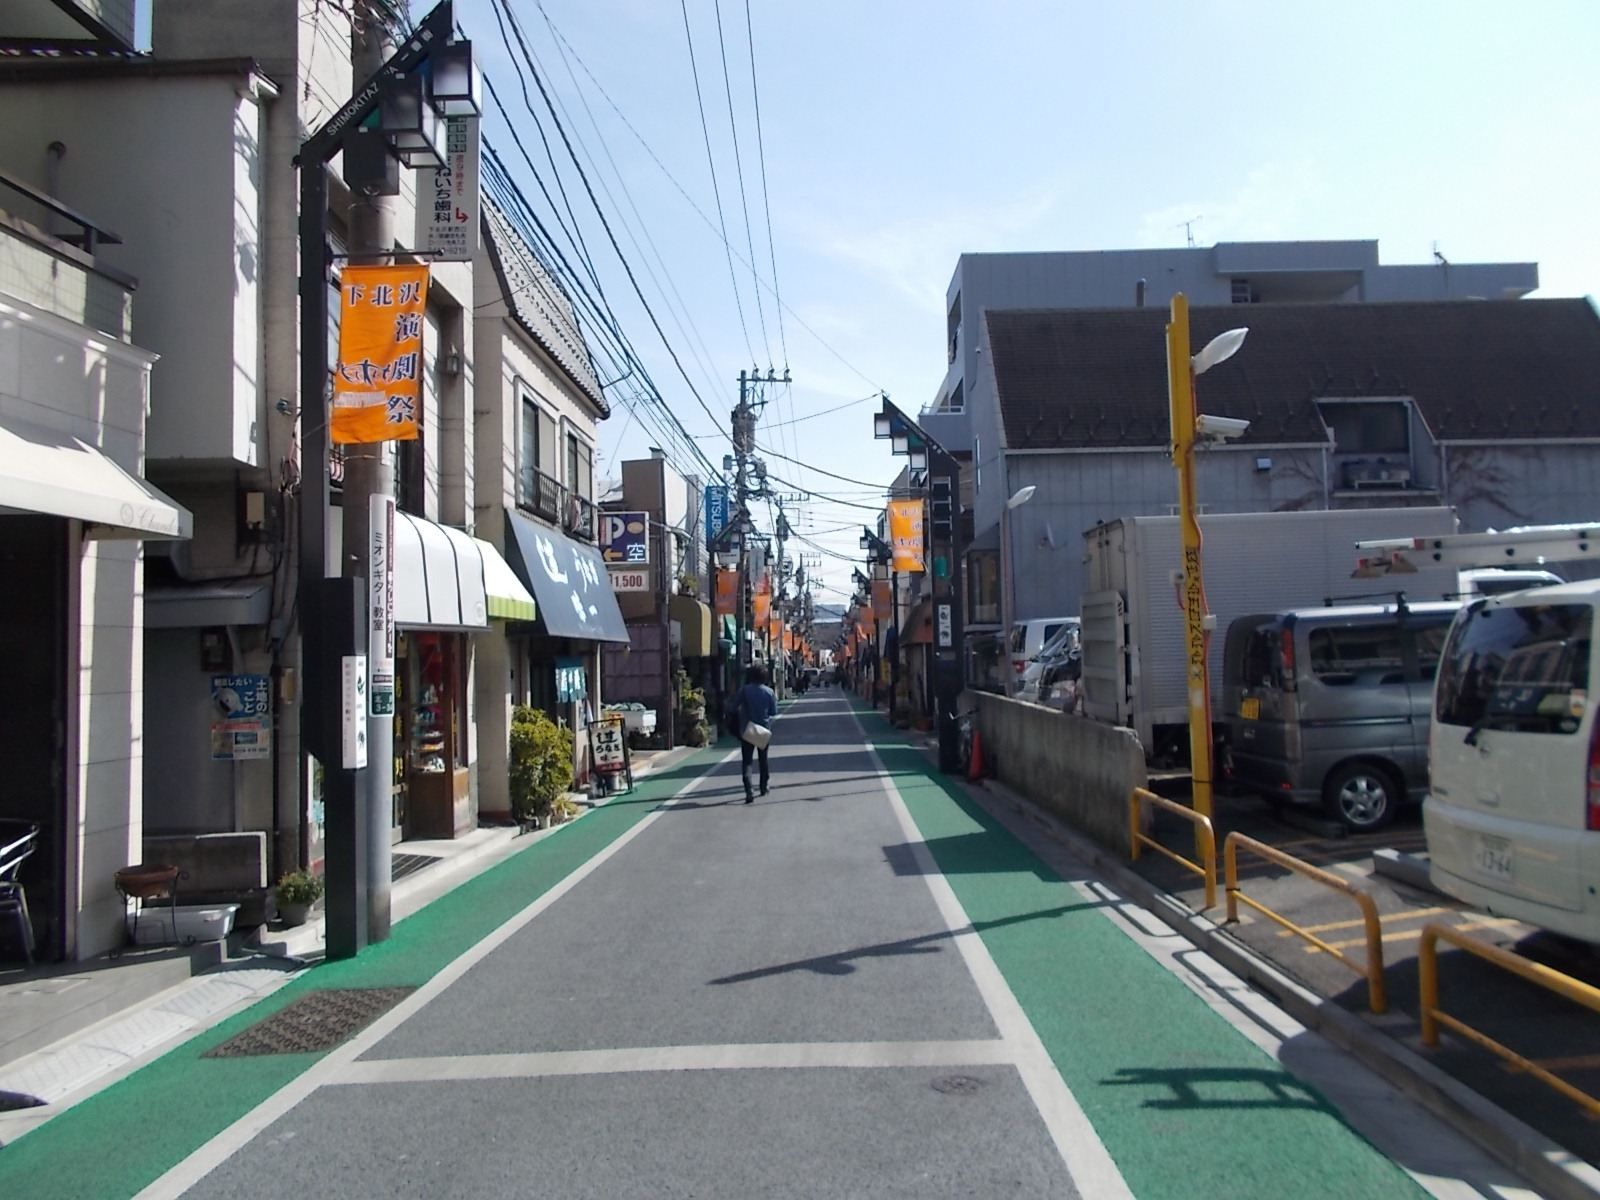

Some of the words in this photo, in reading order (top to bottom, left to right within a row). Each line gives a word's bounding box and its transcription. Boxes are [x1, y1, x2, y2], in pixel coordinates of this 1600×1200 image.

[326, 66, 399, 136] SHIMOKITAZA
[434, 156, 451, 223] ねいち歯科
[344, 282, 420, 305] 下北沢
[388, 313, 422, 423] 演劇祭
[601, 517, 625, 545] P
[627, 543, 645, 561] 空
[615, 575, 642, 589] 1,500
